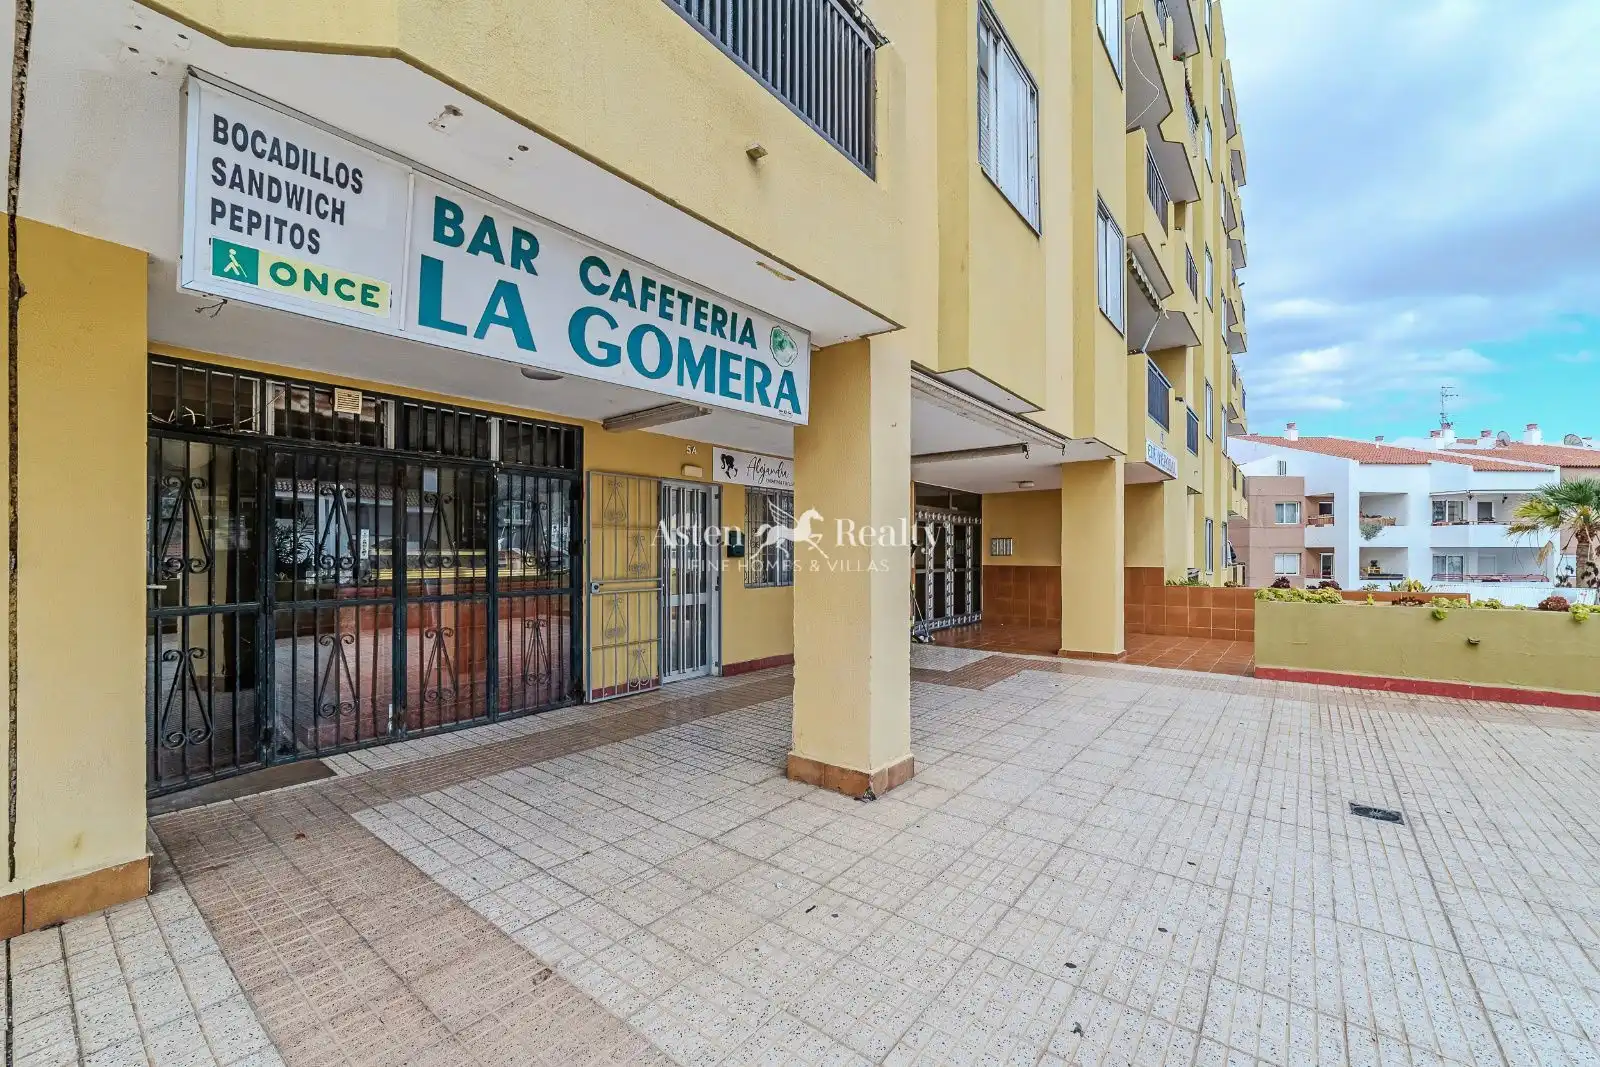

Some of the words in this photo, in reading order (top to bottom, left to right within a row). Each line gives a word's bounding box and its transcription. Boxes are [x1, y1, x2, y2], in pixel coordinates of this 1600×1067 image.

[211, 156, 346, 226] SANDWICH
[212, 113, 363, 195] BOCADILLOS
[210, 197, 321, 255] PEPITOS
[269, 261, 381, 309] ONCE
[433, 195, 541, 277] BAR
[579, 255, 758, 350] CAFETERIA
[418, 254, 538, 353] LA
[568, 306, 803, 415] GOMERA
